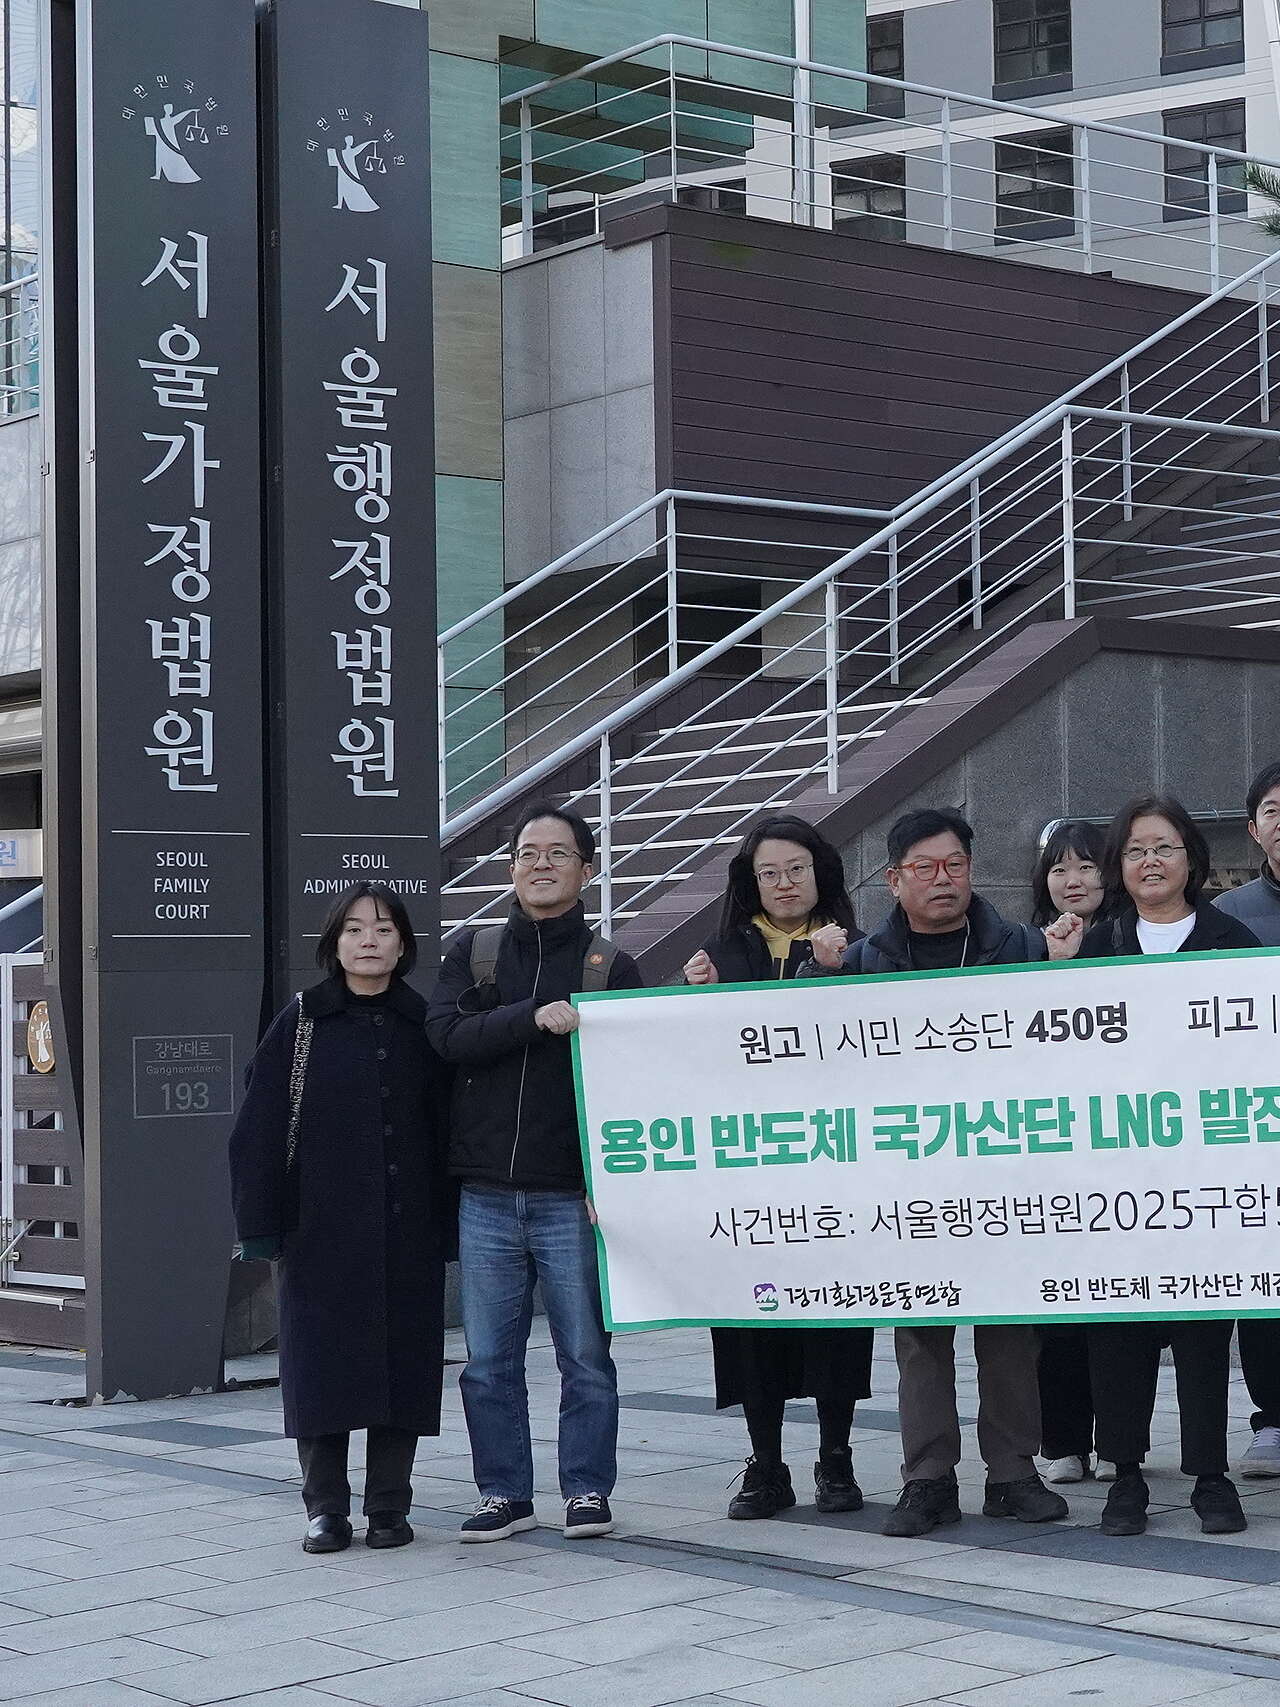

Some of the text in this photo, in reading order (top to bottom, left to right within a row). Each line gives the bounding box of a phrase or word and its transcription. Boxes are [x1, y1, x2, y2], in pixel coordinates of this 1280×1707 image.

[138, 230, 221, 792] 서울가정법원
[322, 257, 400, 798] 서울행정법원
[156, 851, 209, 867] SEOUL
[342, 854, 390, 869] SEOUL
[154, 878, 210, 893] FAMILY
[303, 879, 427, 894] ADMINATIVE
[155, 904, 210, 919] COURT
[1187, 995, 1259, 1038] 피고
[739, 1024, 807, 1065] 원고
[836, 1016, 902, 1059] 시민
[914, 1009, 1015, 1053] 소송단
[1025, 1001, 1128, 1044] 450명
[154, 1041, 213, 1059] 강남대로
[161, 1082, 210, 1111] 193
[600, 1116, 697, 1174] 용인
[710, 1107, 857, 1169] 반도체
[872, 1096, 1076, 1160] 국가산단
[1088, 1091, 1184, 1150] LNG
[709, 1204, 855, 1247] 사건번호:
[784, 1281, 962, 1311] 경기환경운동연합
[1039, 1277, 1081, 1303] 용인
[1087, 1275, 1151, 1301] 반도체
[1157, 1272, 1244, 1300] 국가산단
